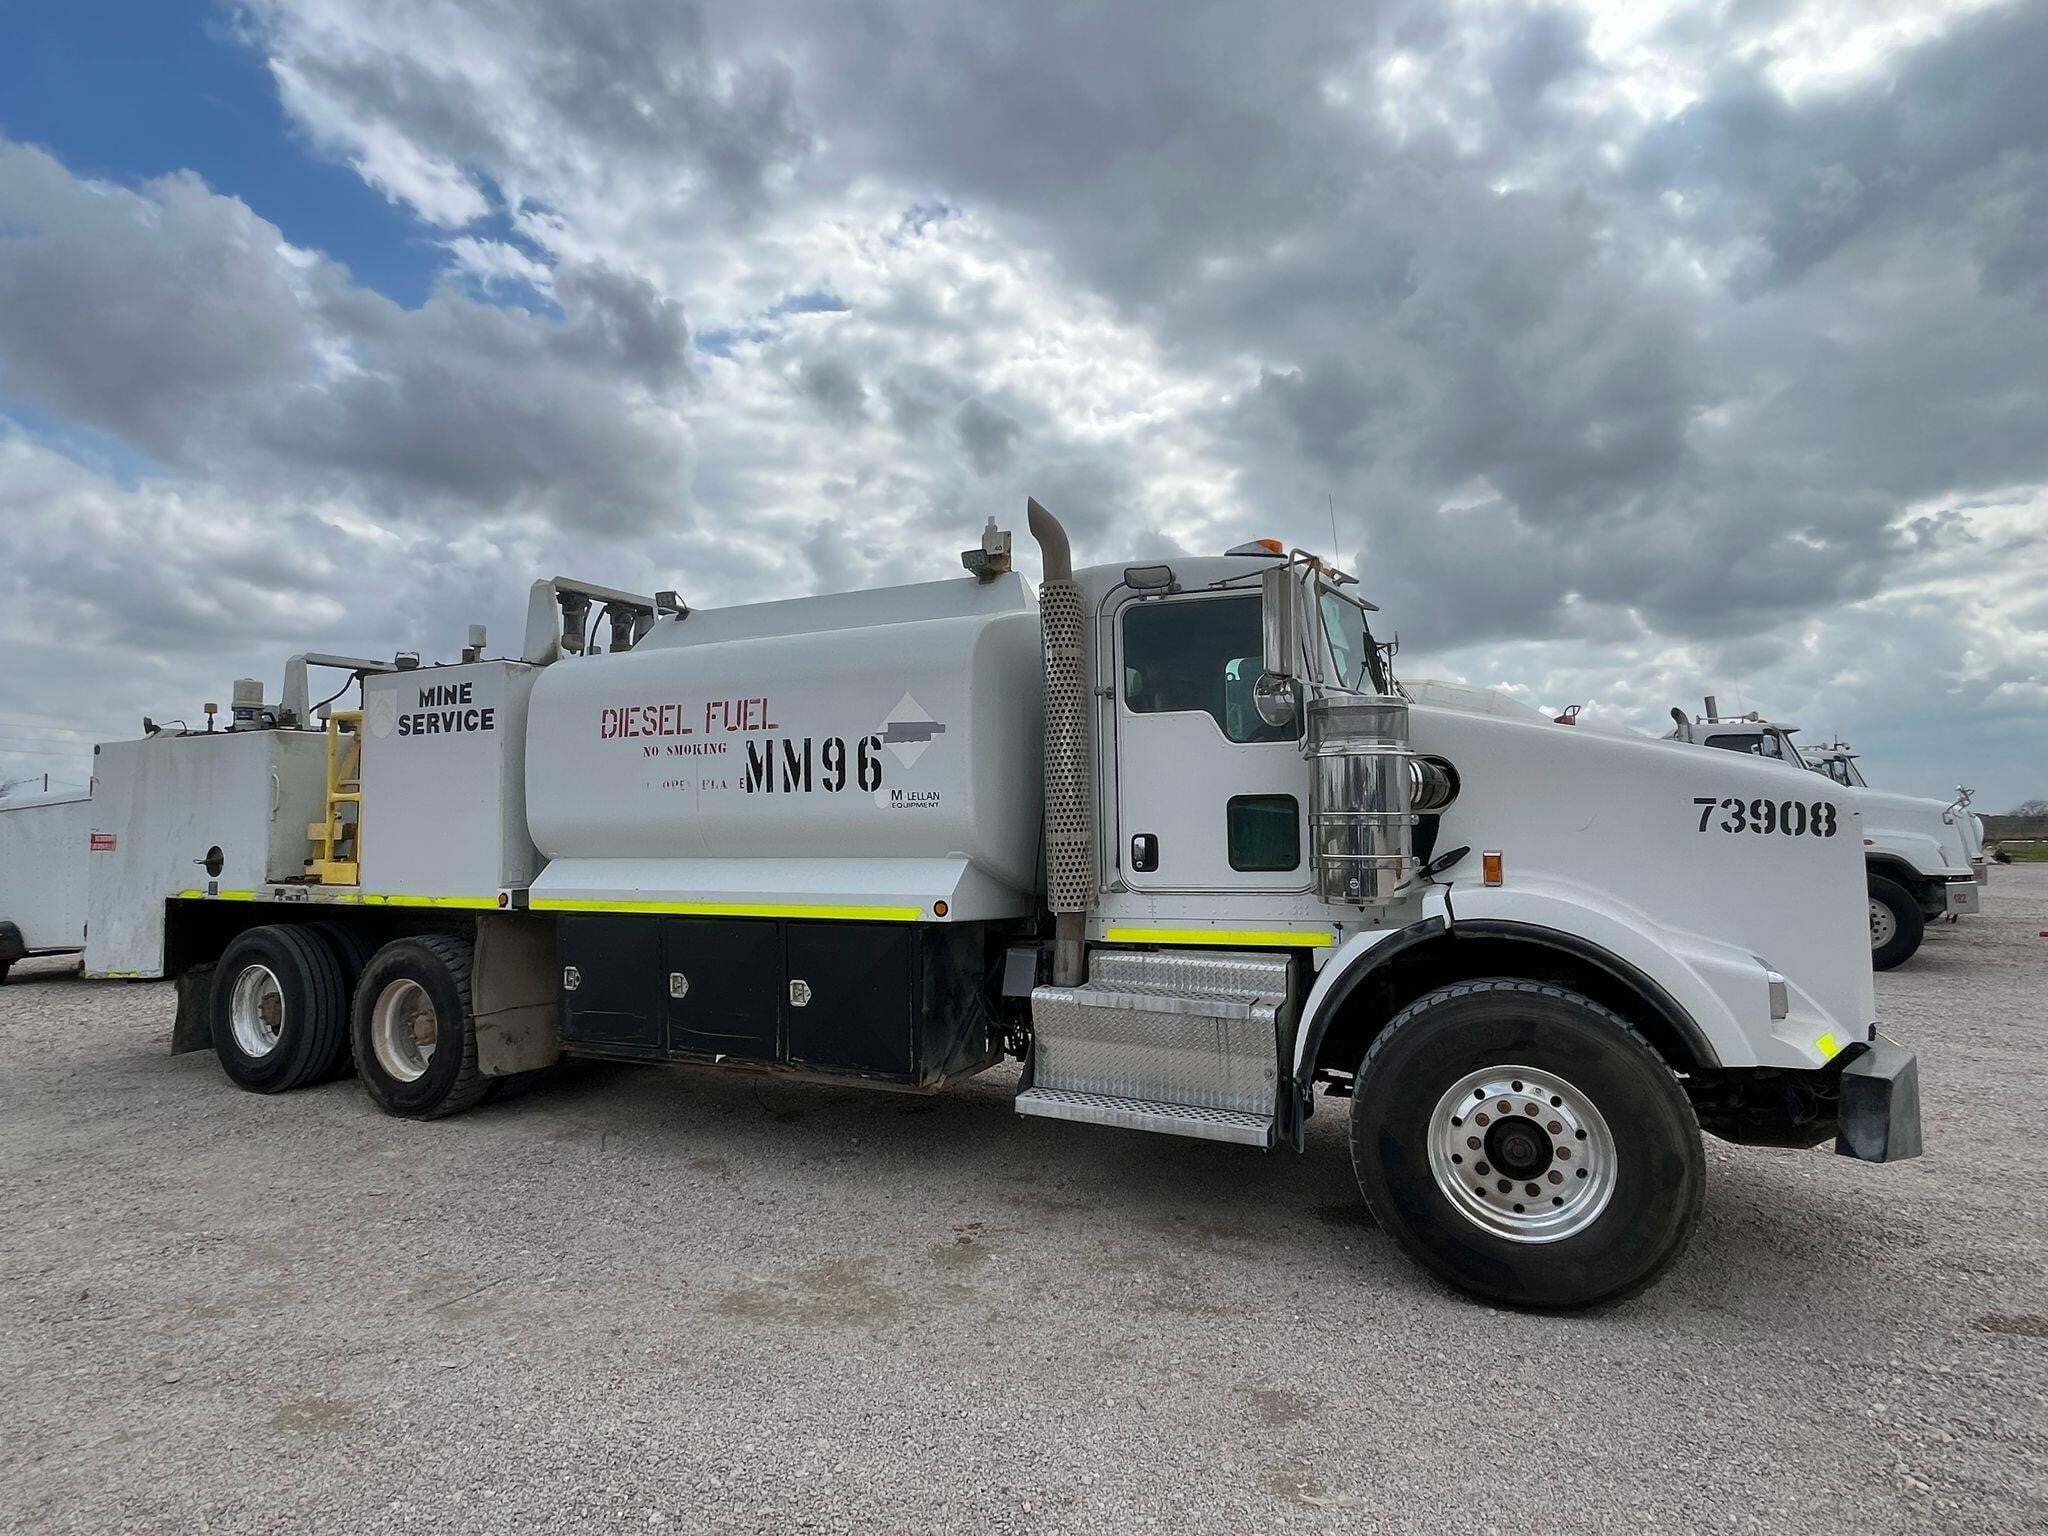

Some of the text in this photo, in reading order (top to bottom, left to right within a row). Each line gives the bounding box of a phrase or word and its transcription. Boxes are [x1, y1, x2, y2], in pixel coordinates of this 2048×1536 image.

[419, 682, 473, 708] MINE
[398, 708, 495, 737] SERVICE
[601, 698, 779, 739] DIESEL FUEL
[643, 742, 727, 758] NO SMOKING
[745, 735, 882, 794] MM96
[1693, 797, 1837, 838] 73908
